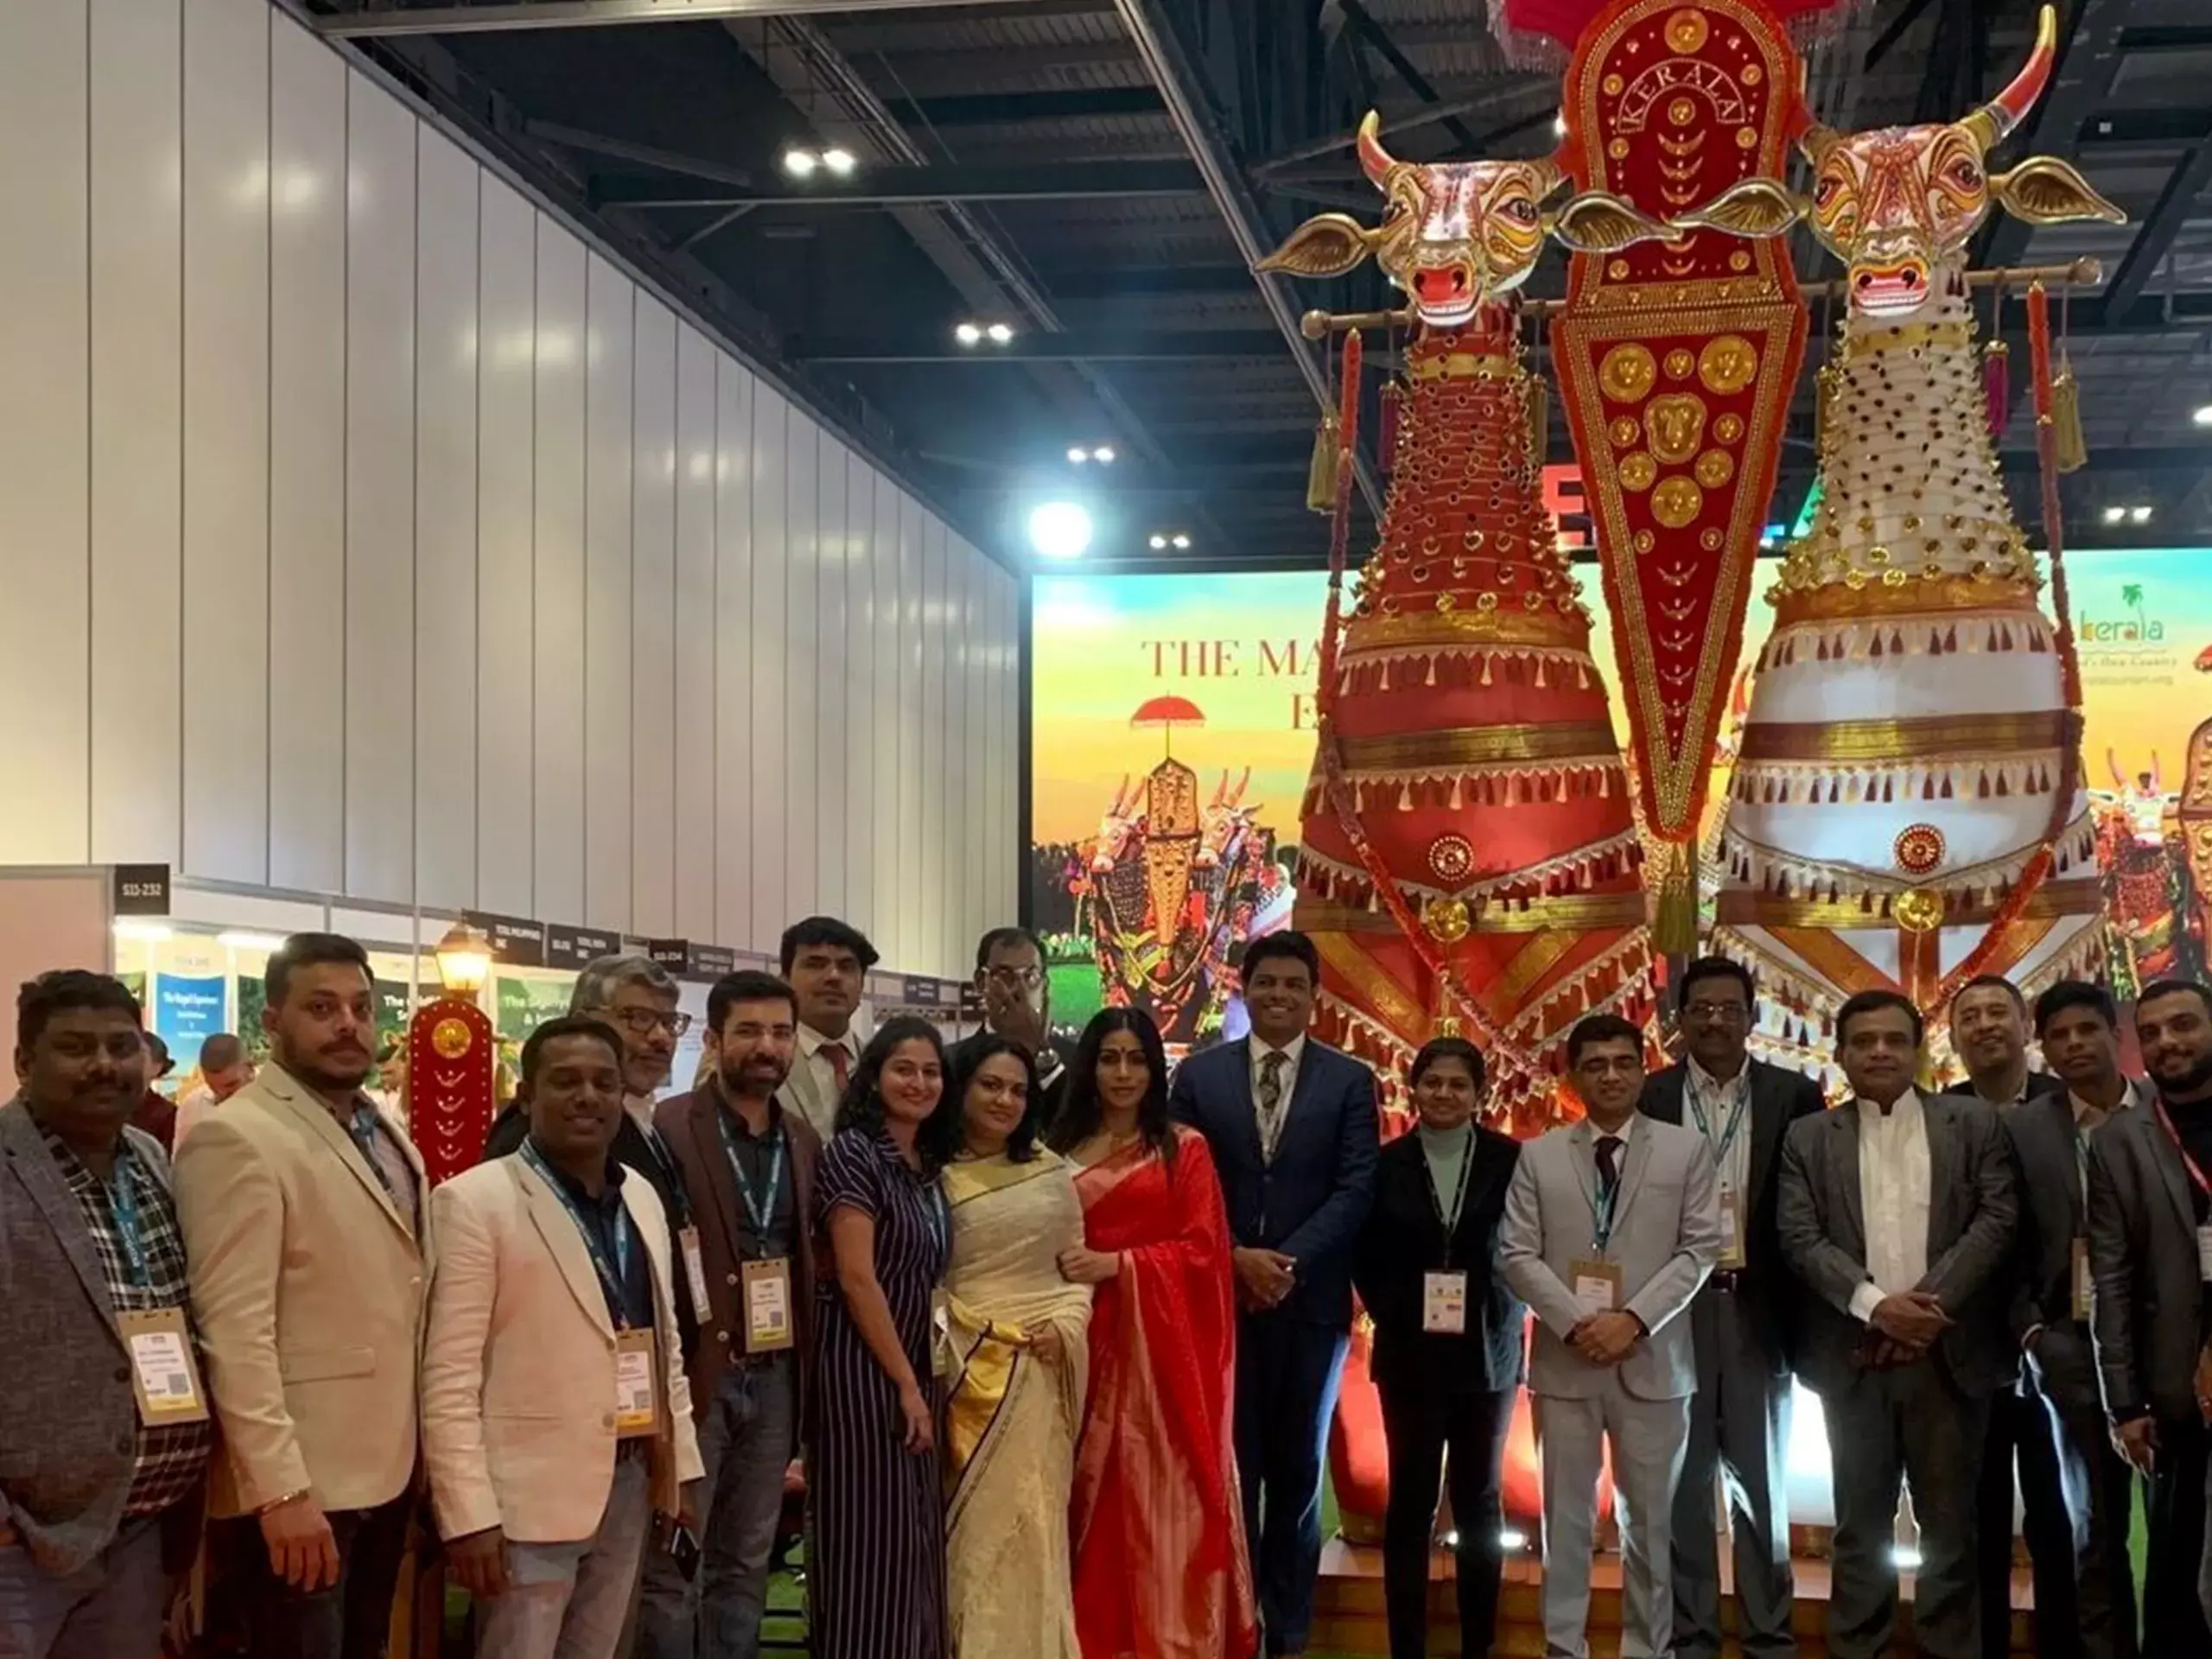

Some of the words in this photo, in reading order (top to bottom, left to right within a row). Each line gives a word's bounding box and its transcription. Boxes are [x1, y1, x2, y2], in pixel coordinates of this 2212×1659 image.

[1622, 62, 1738, 124] KERALA
[2081, 608, 2164, 641] kerala
[1141, 640, 1239, 677] THE
